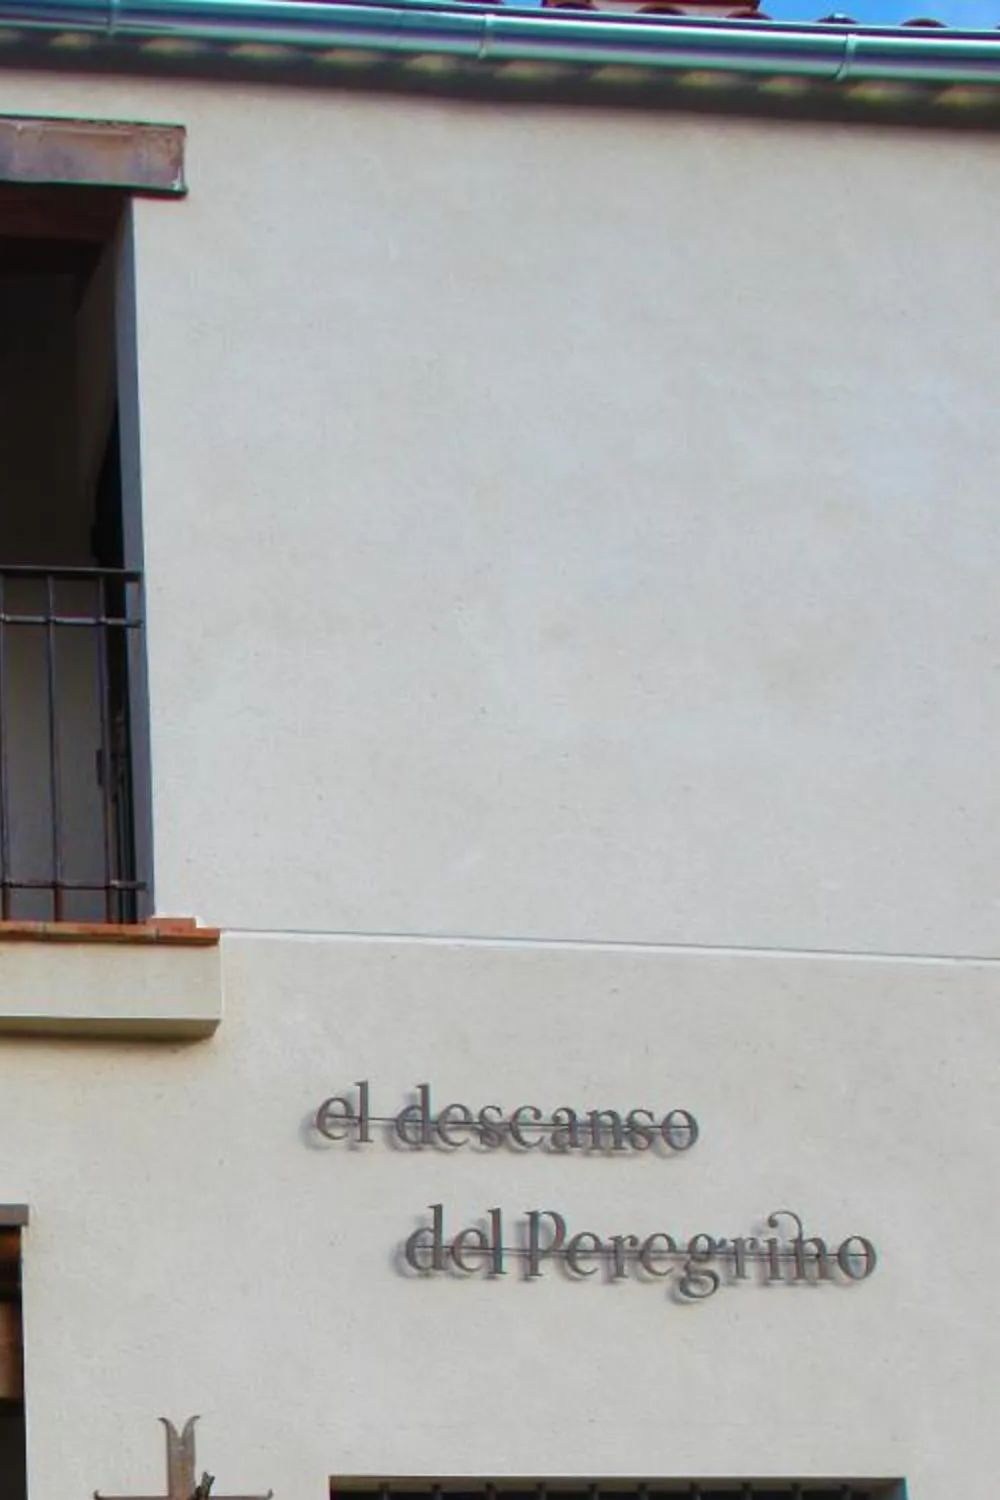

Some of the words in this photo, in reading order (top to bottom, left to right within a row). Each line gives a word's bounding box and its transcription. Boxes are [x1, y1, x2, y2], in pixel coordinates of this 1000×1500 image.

[316, 1080, 374, 1143] el
[396, 1083, 699, 1152] descanso
[405, 1203, 507, 1278] del
[524, 1209, 877, 1299] Peregrino
